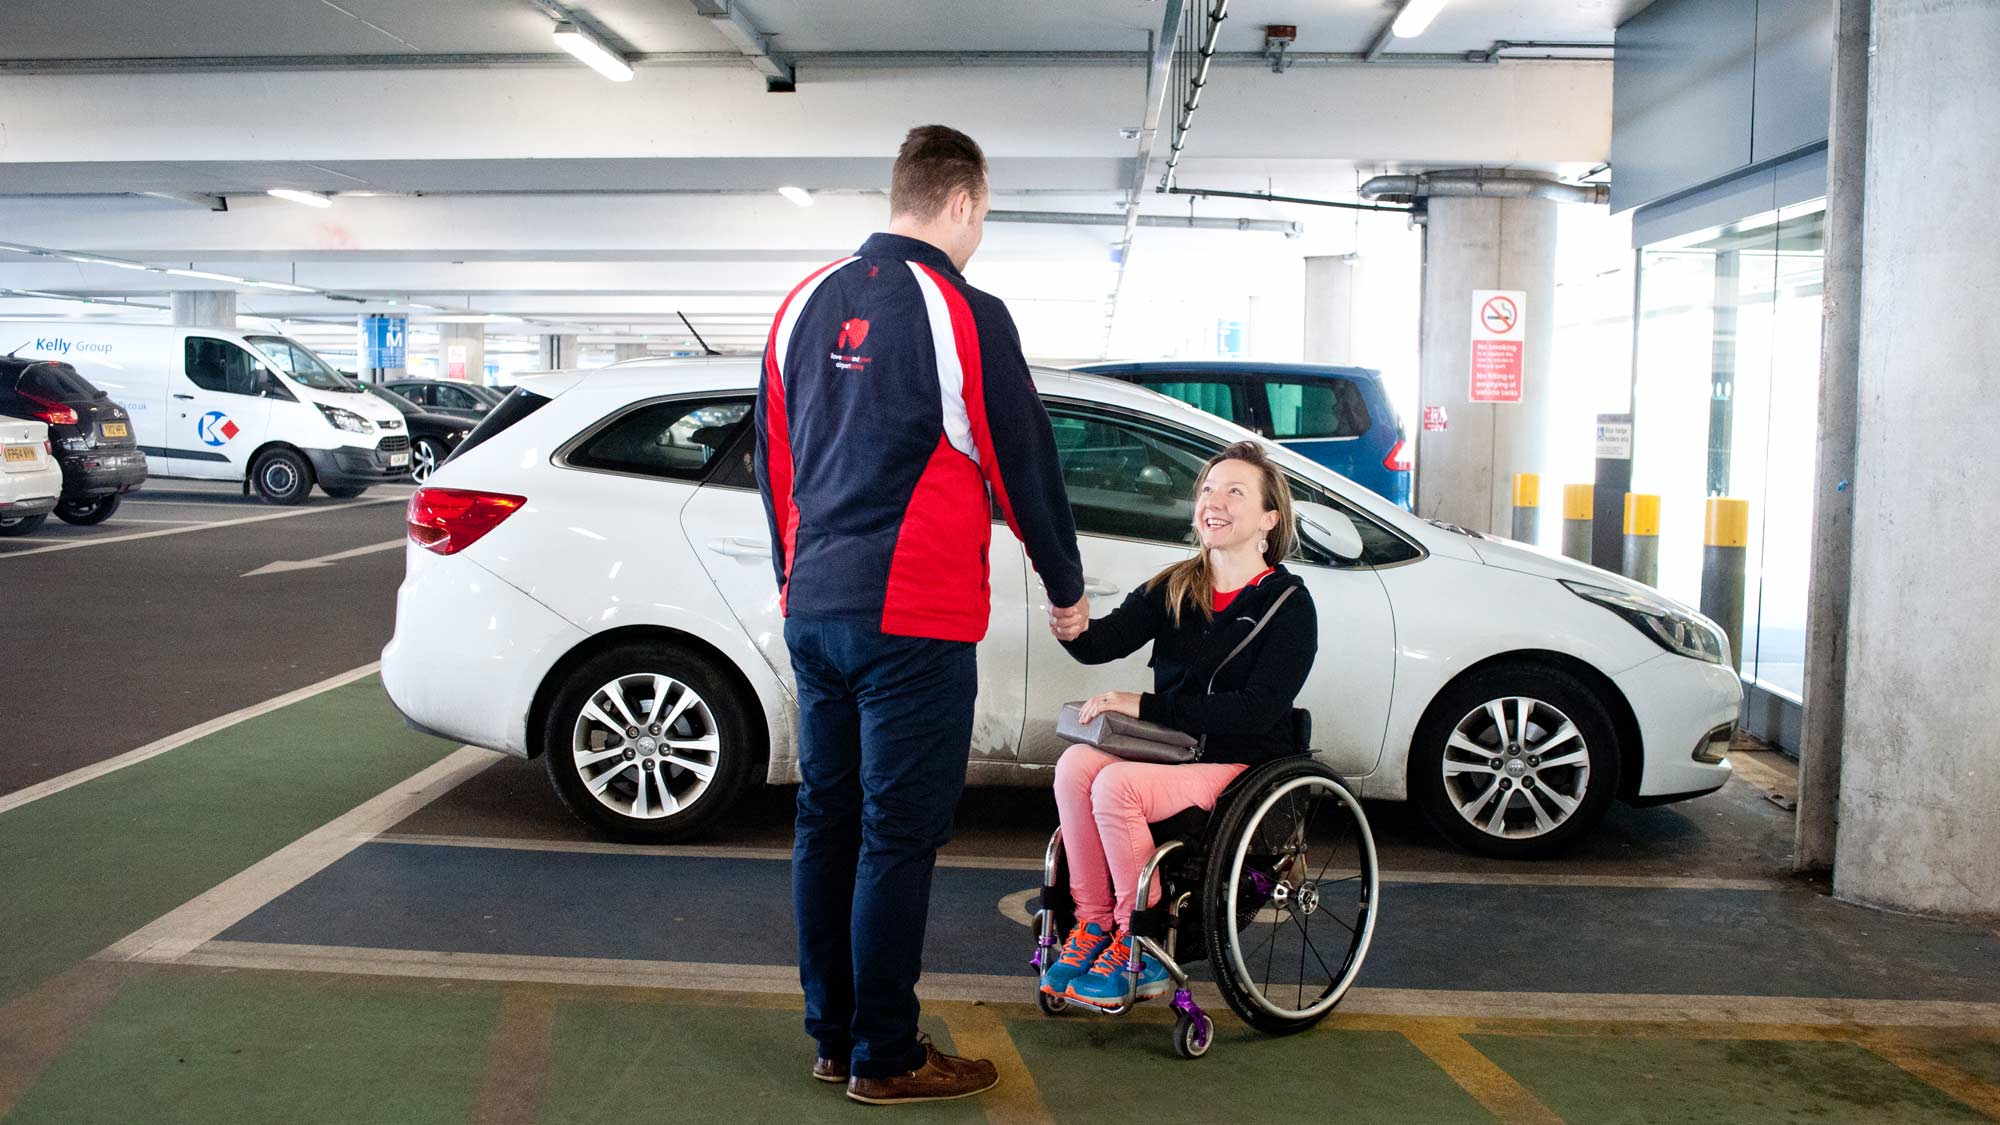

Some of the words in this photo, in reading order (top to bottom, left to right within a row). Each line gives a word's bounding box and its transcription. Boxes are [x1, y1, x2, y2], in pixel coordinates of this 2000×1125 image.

[36, 338, 71, 354] Kelly
[76, 341, 112, 354] Group
[386, 332, 402, 347] M
